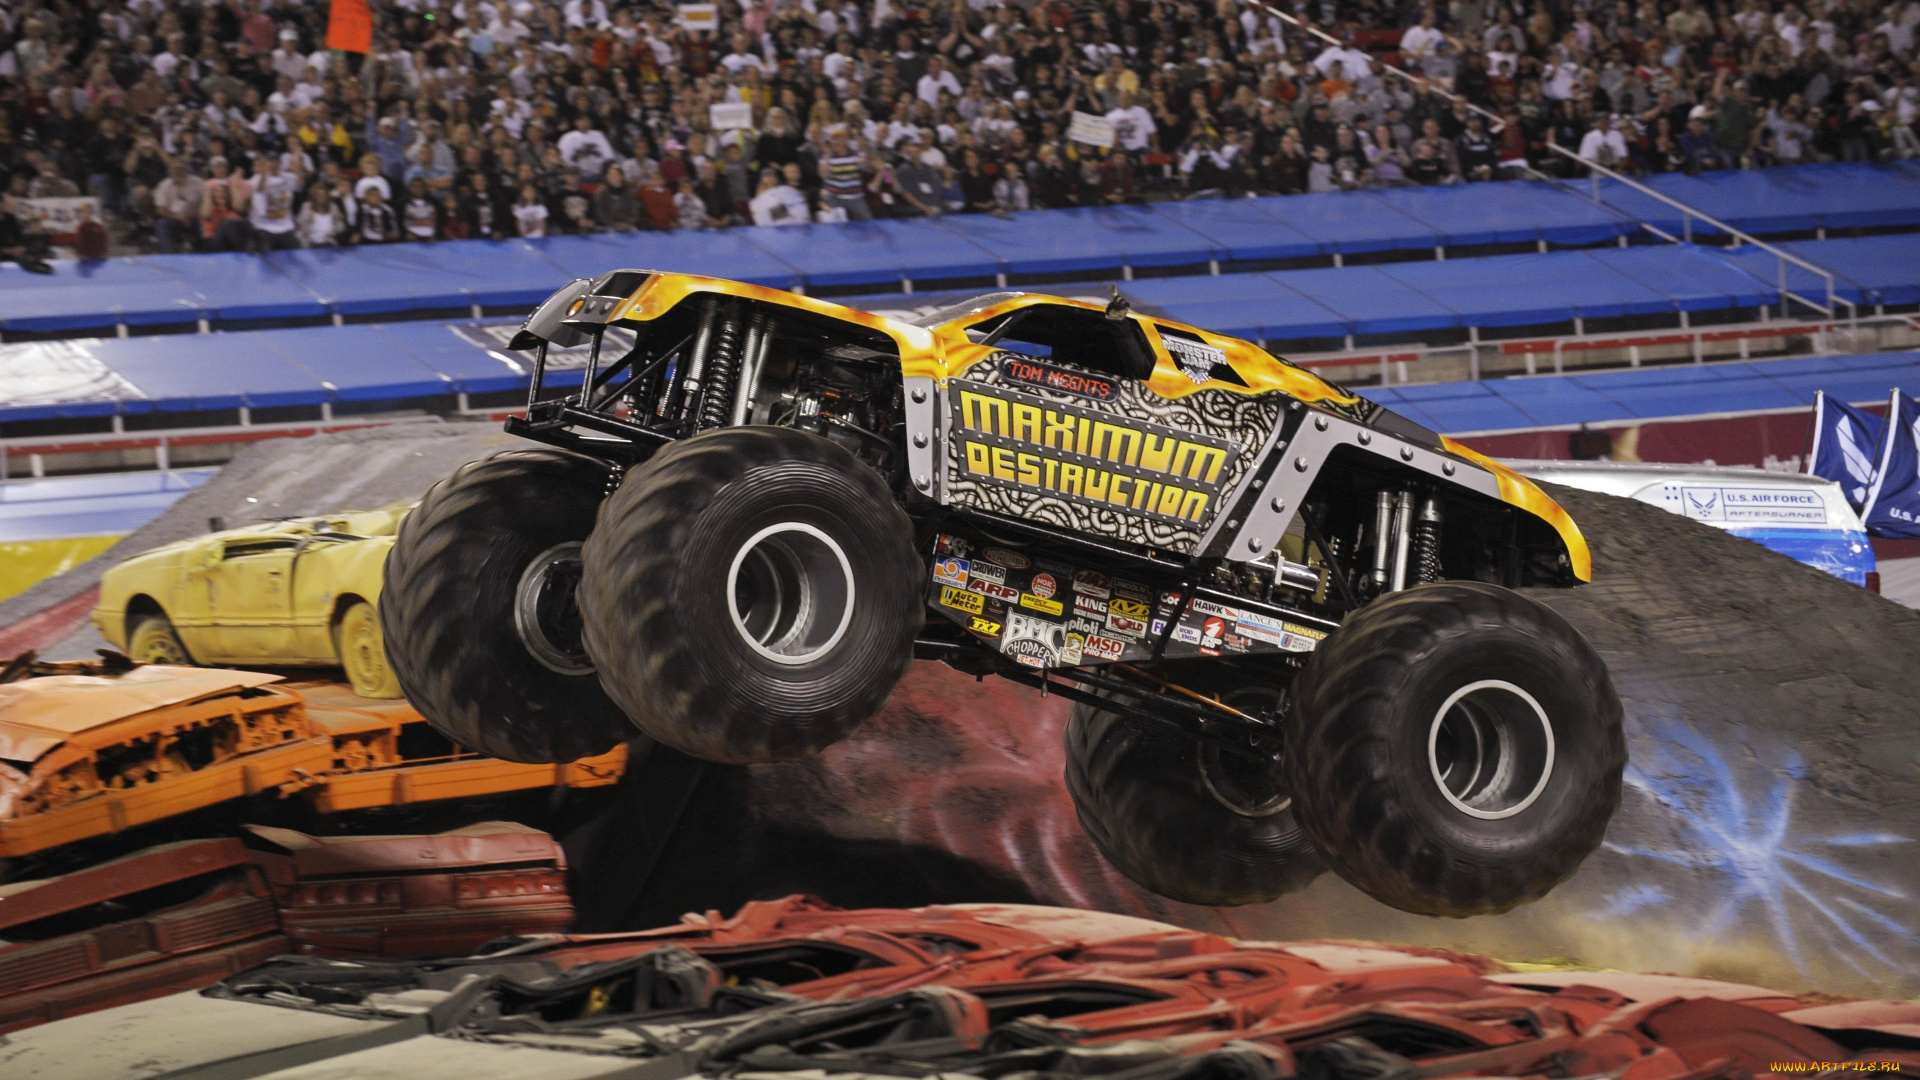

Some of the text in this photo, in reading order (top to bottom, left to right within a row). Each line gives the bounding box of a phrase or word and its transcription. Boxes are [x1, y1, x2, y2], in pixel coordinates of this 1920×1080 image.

[1162, 340, 1227, 365] MONSTER
[1180, 354, 1211, 371] JAM
[1010, 362, 1111, 398] TOM MEENTS
[960, 390, 1228, 484] MAXIMUM
[965, 441, 1209, 523] DESTRUCTION
[1727, 495, 1814, 504] U.S. AIR FORCE
[1729, 511, 1822, 519] AFTERBURNER
[972, 561, 1006, 579] CROWER
[970, 580, 1019, 600] ARP
[1113, 580, 1147, 593] LINCOLN
[951, 598, 982, 611] Meter
[955, 592, 979, 603] Auto
[1075, 595, 1109, 613] KING
[1194, 600, 1224, 614] HAWK
[973, 620, 1002, 634] TX7
[1068, 617, 1100, 635] piloti
[1240, 612, 1282, 627] LANCE'S
[1007, 641, 1055, 667] CHOPPERS
[1087, 636, 1123, 654] MSD
